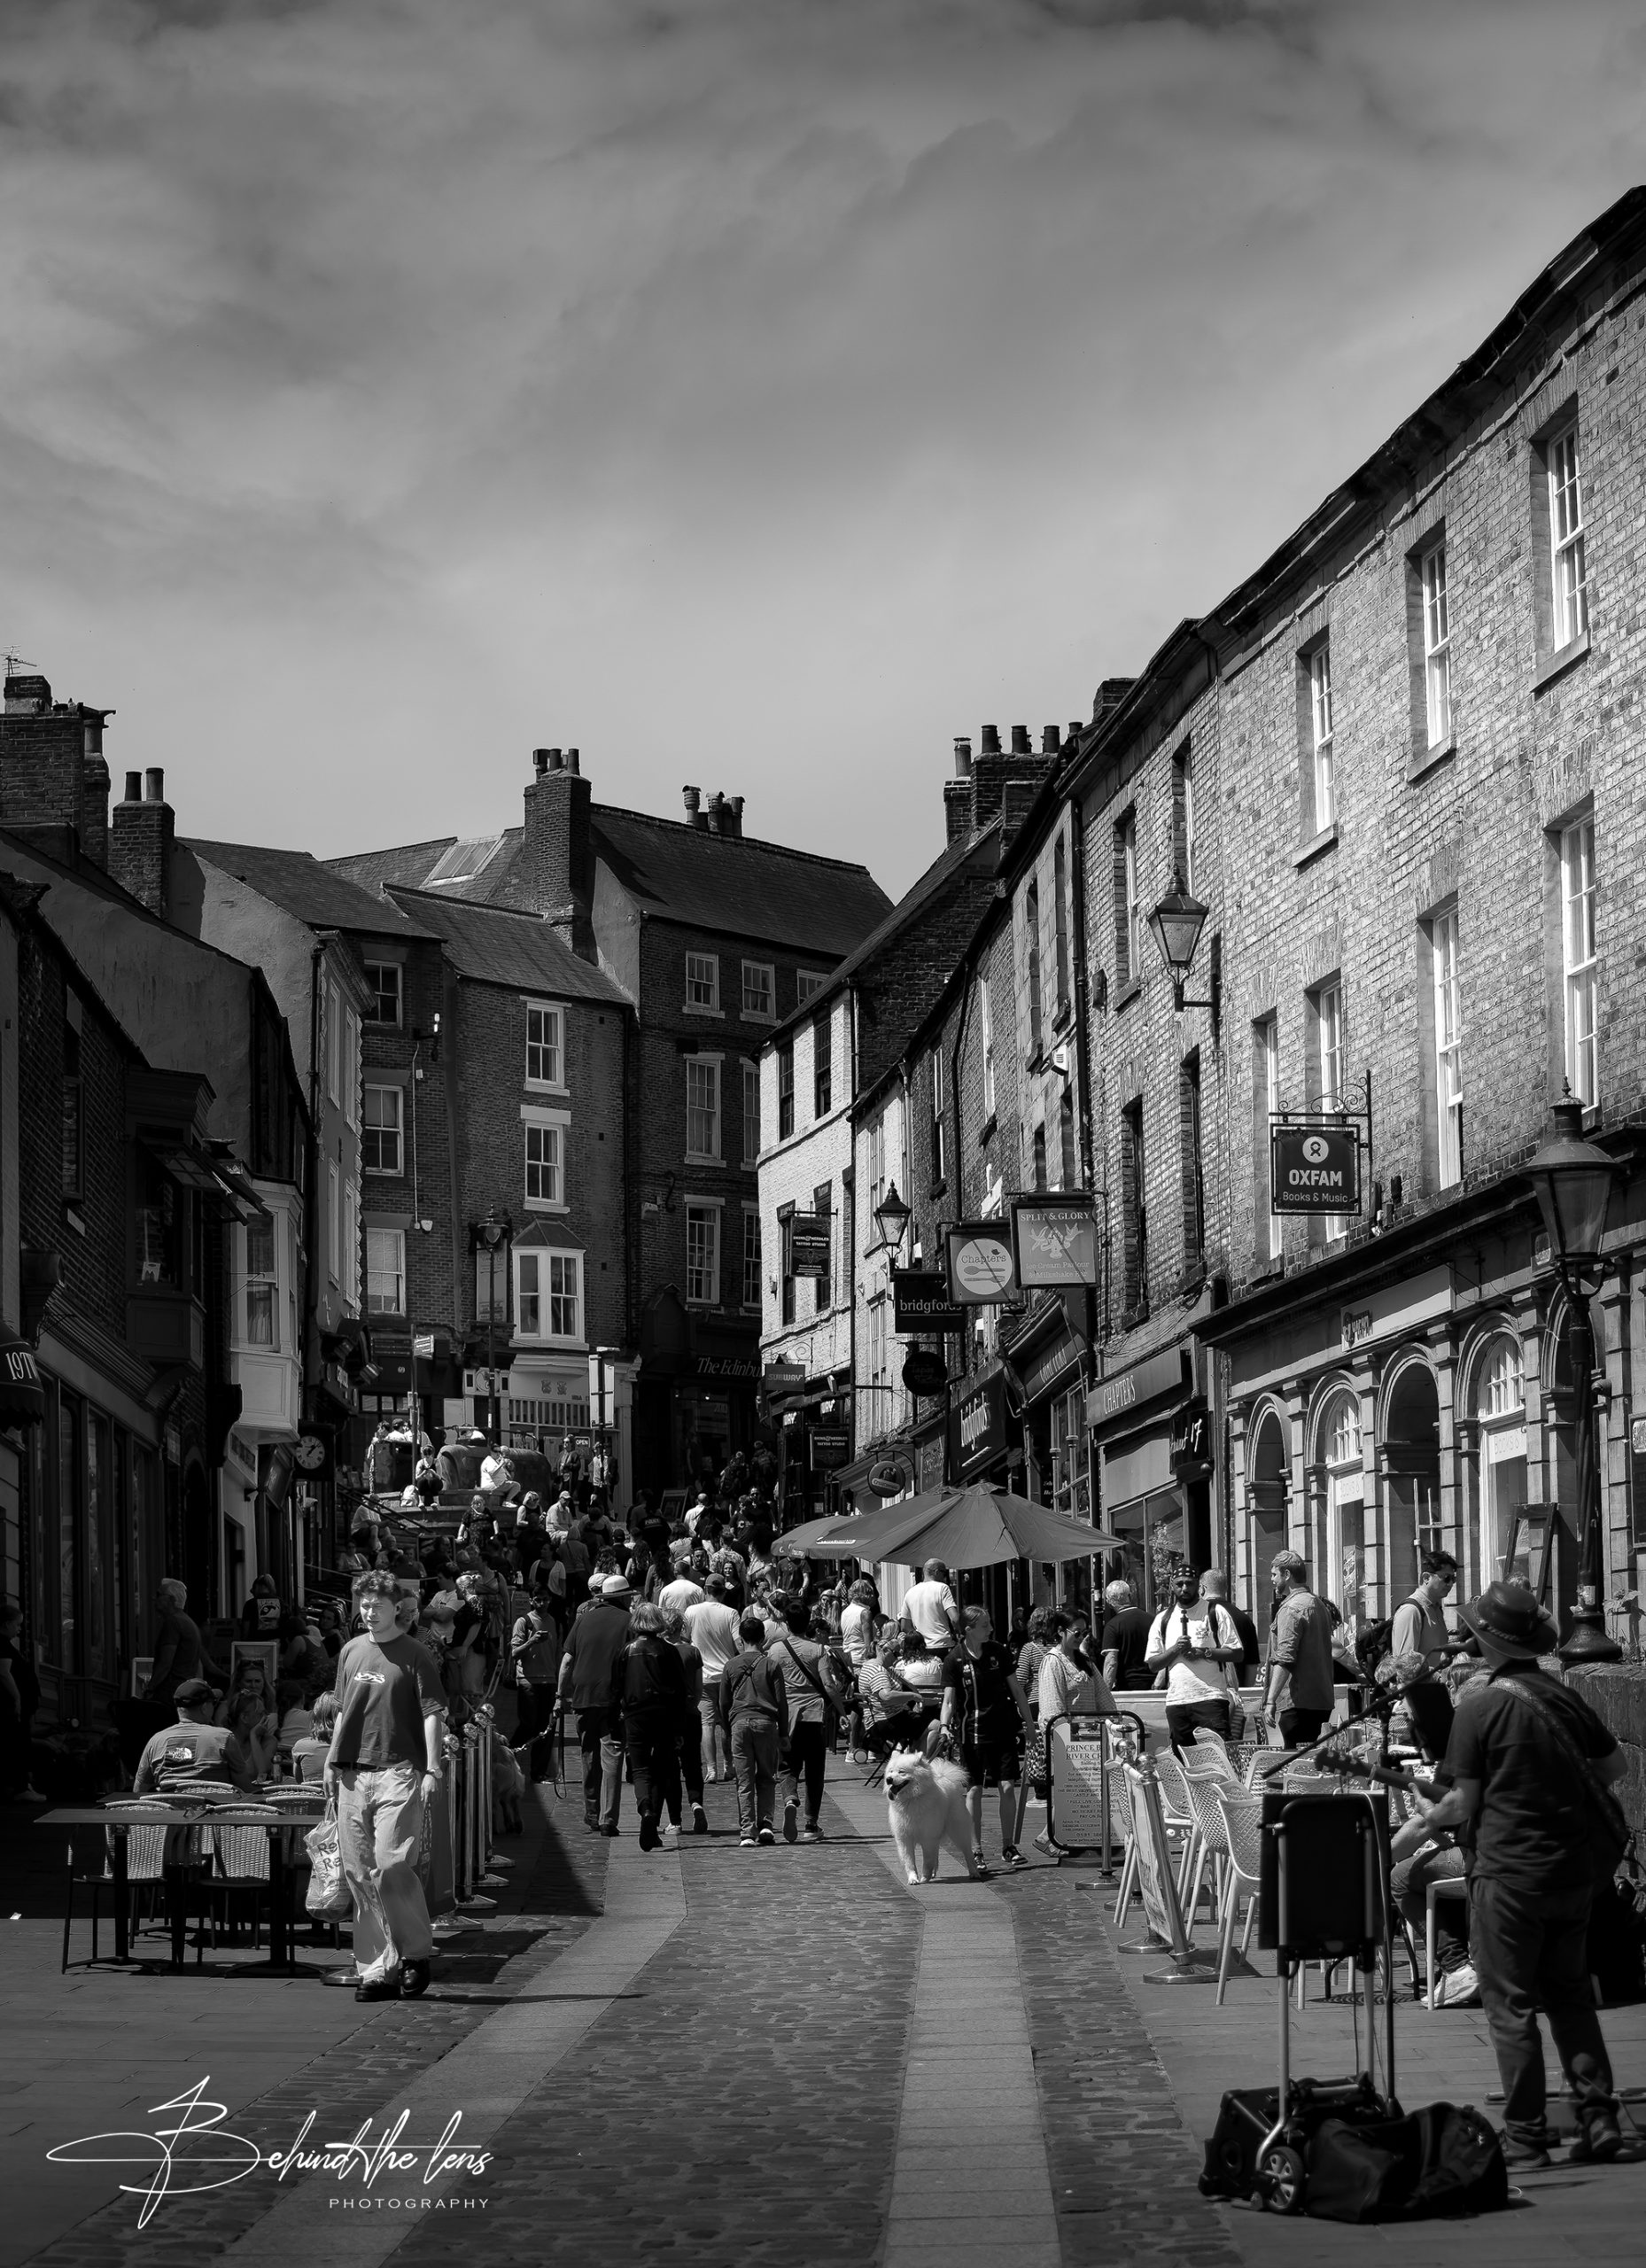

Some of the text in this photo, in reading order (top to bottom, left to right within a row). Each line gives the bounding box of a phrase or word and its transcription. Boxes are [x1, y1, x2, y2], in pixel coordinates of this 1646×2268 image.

[1289, 1169, 1342, 1186] OXFAM
[1283, 1192, 1347, 1202] Books & Music
[1021, 1211, 1091, 1222] SPLIT & GLORY
[961, 1255, 1006, 1264] Chapters
[696, 1356, 762, 1378] The Edinbu
[767, 1373, 804, 1382] SUBWAY
[1103, 1375, 1136, 1415] CHAPTERS
